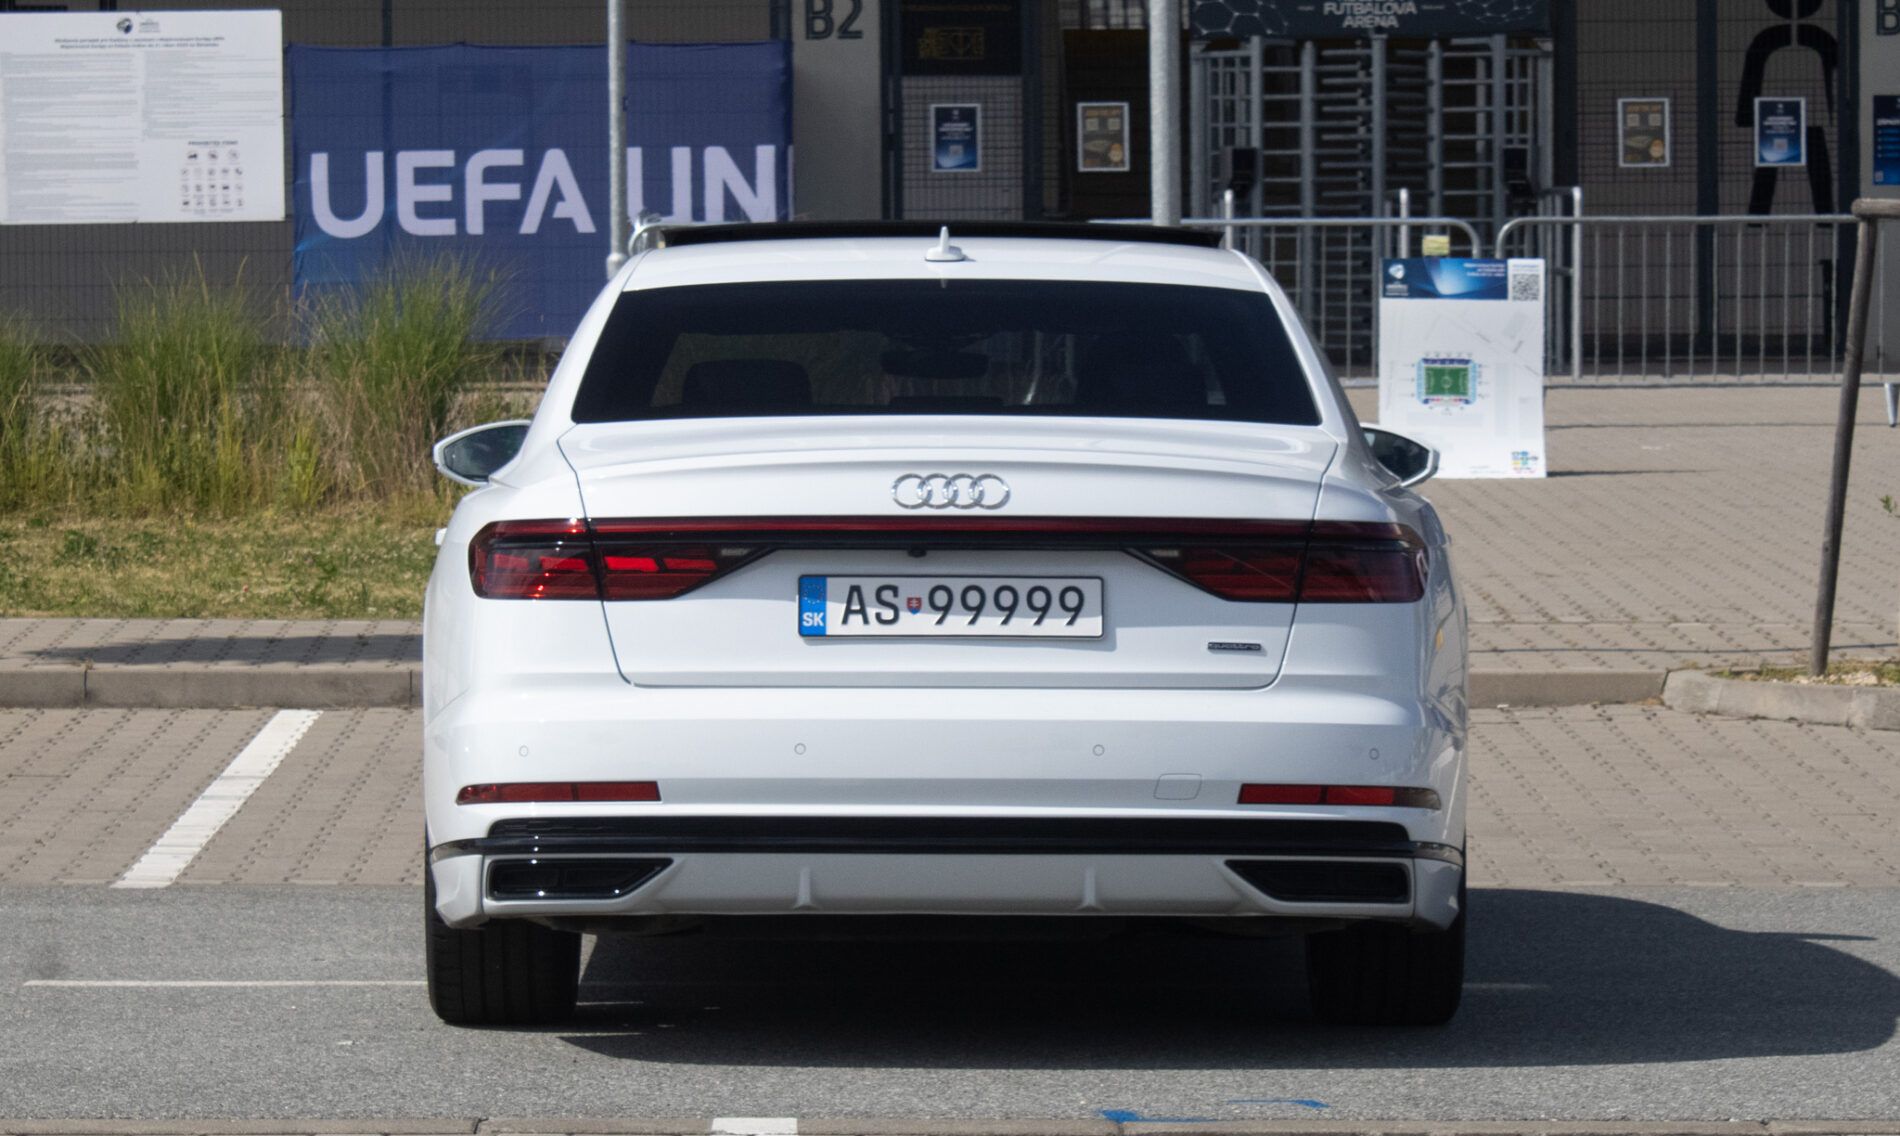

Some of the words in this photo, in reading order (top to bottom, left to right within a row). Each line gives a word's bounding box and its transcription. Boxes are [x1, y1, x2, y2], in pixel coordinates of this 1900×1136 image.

[805, 0, 863, 39] B2
[310, 148, 596, 239] UEFA
[627, 145, 794, 222] UN
[802, 611, 824, 627] SK
[841, 584, 899, 626] AS
[928, 584, 1085, 626] 99999
